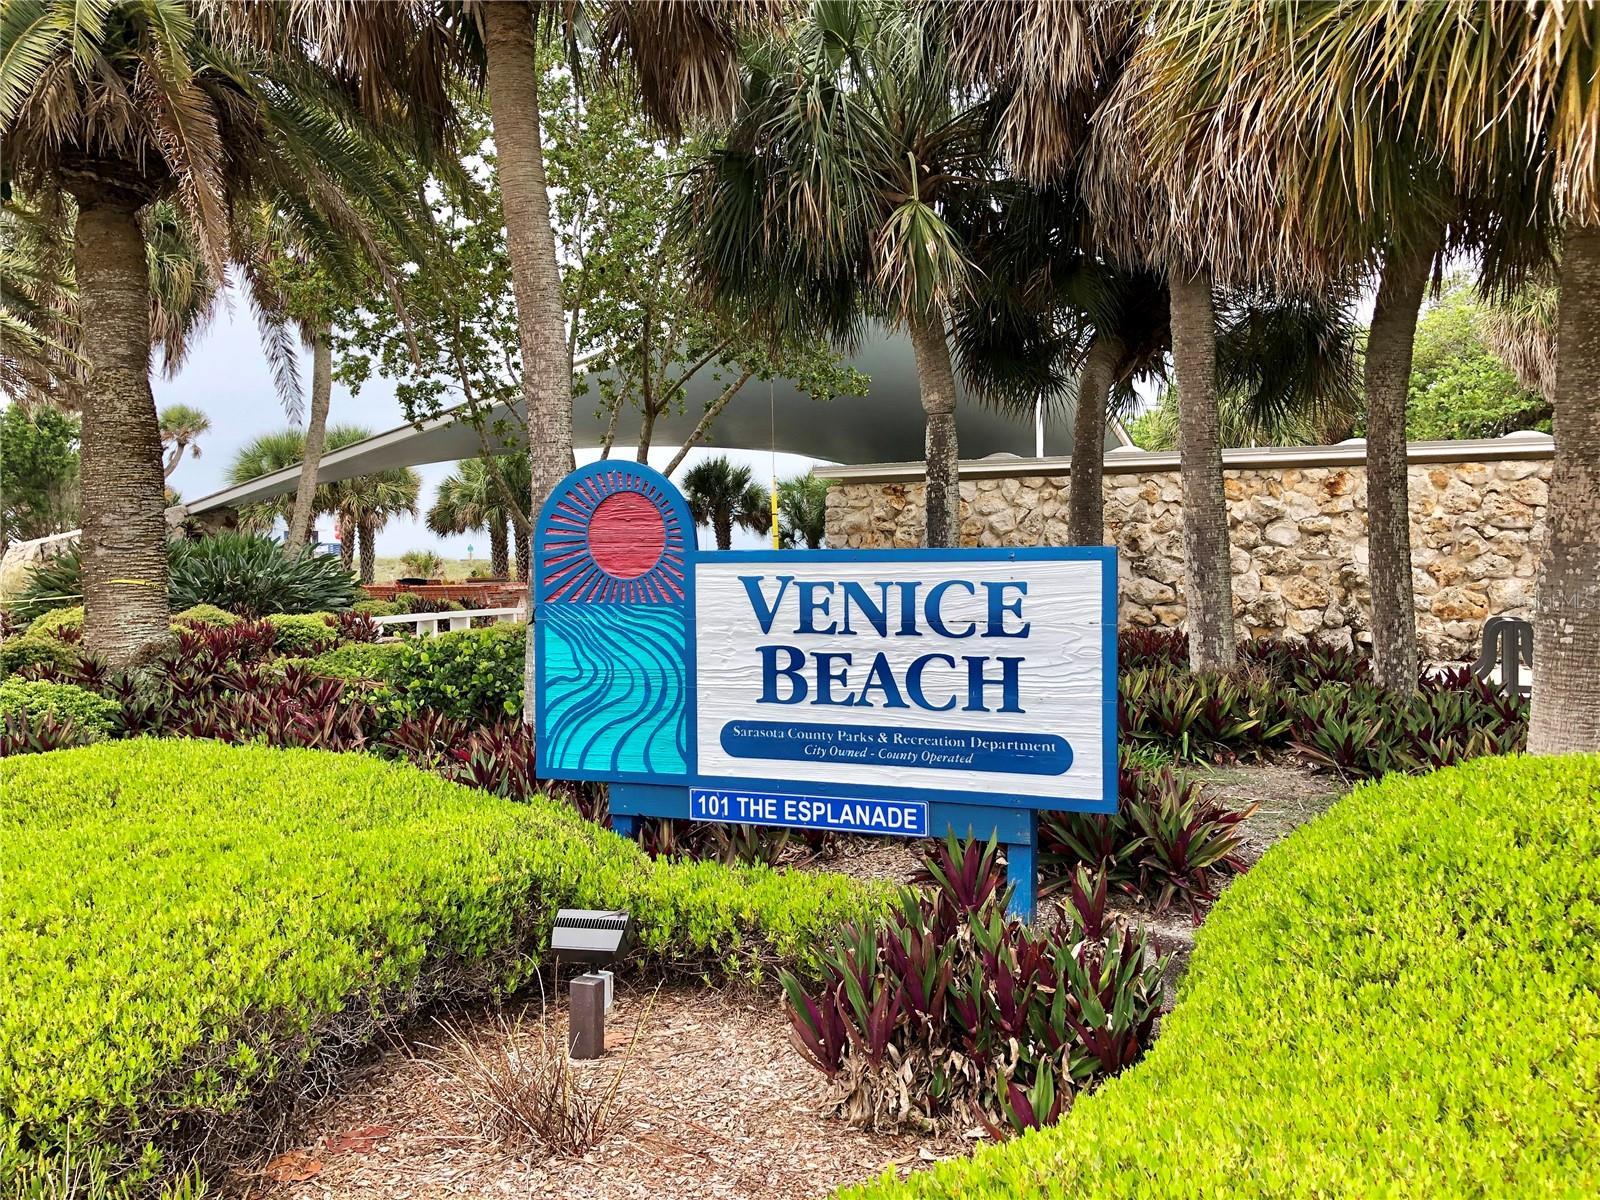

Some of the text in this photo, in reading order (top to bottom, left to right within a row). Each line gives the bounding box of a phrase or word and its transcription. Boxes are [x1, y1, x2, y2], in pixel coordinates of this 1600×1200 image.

[737, 575, 1031, 639] VENICE
[755, 645, 1026, 714] BEACH
[733, 725, 1056, 752] Sarasota County Parks & Recreation Department
[804, 744, 827, 758] City
[829, 745, 868, 758] Owned
[878, 748, 918, 762] County
[920, 750, 974, 764] Operated
[698, 794, 918, 830] 101 THE ESPLANADE
